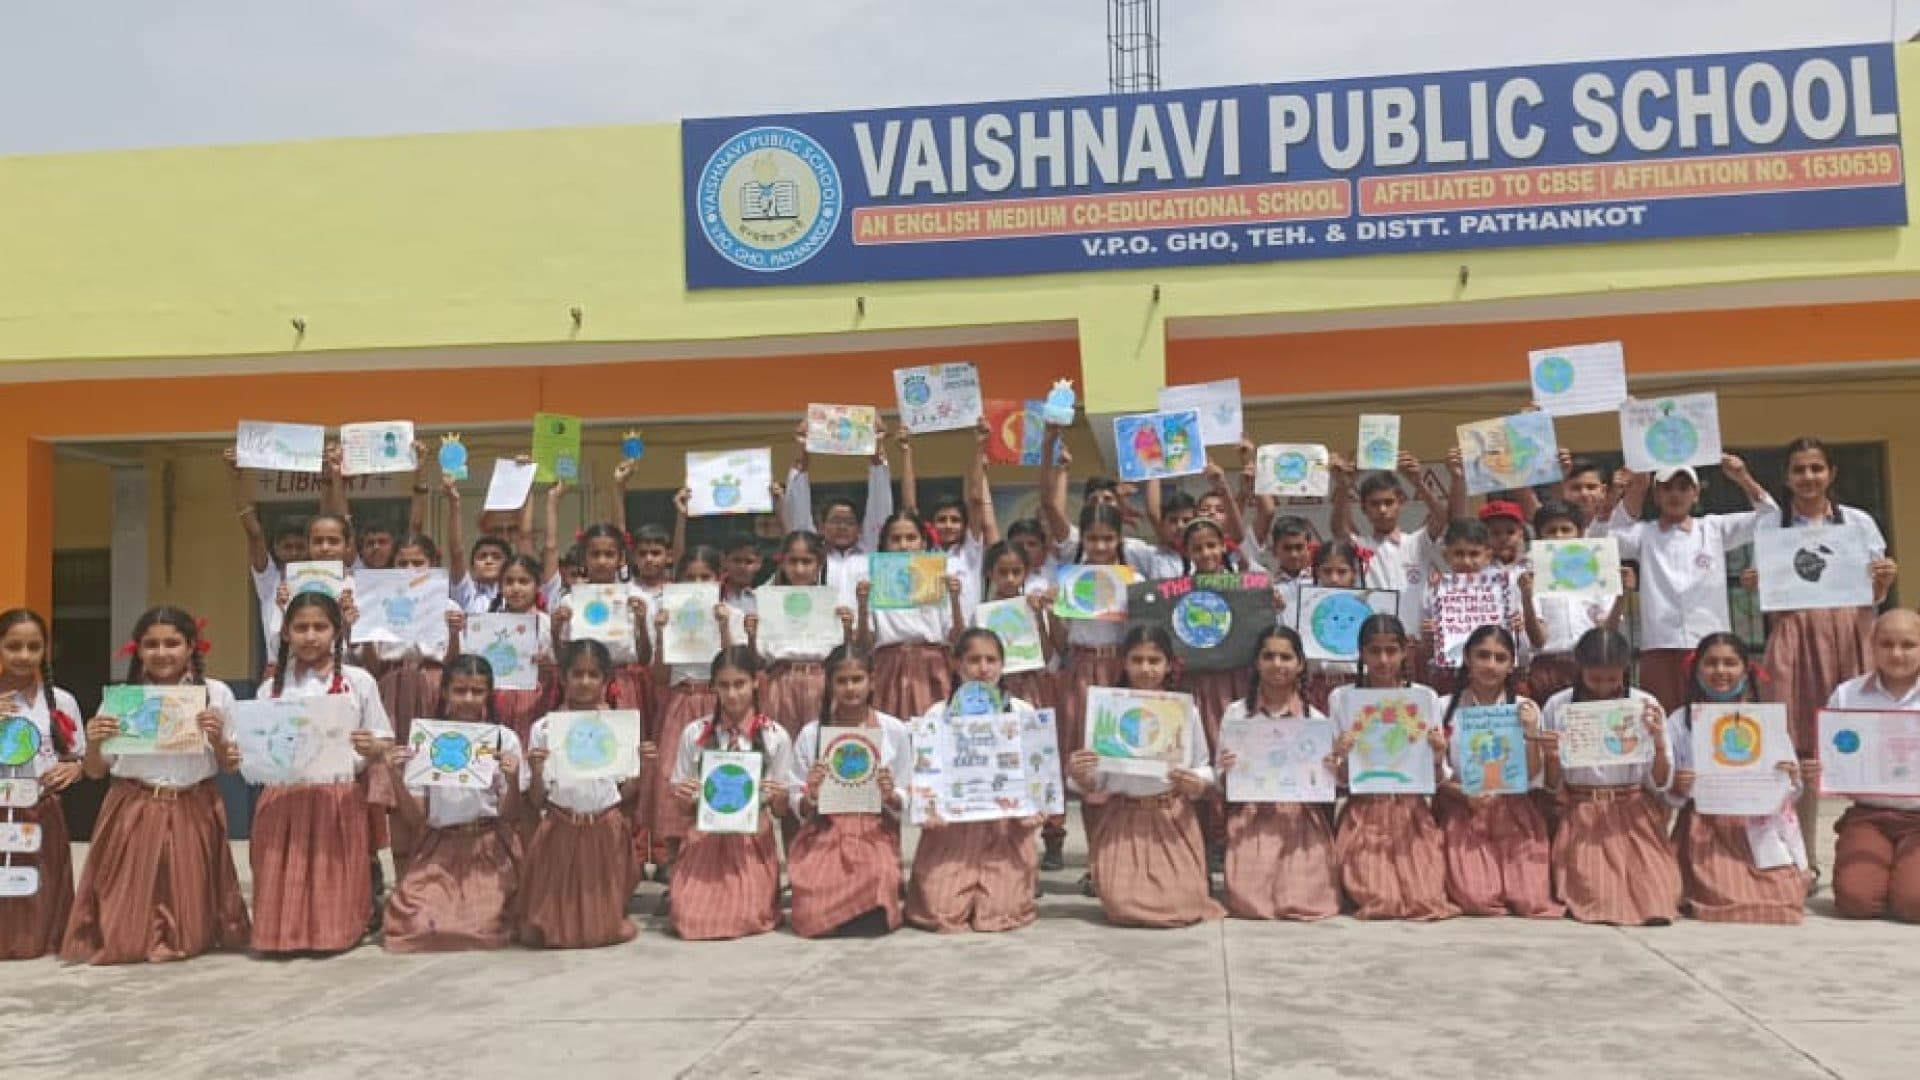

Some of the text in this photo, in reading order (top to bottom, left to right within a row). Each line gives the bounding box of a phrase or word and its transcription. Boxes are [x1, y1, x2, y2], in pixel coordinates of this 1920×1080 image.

[853, 55, 1899, 197] VAISHNAVI PUBLIC SCHOOL
[749, 133, 802, 153] PUBLIC
[803, 147, 836, 206] SCHOOL
[1373, 151, 1893, 205] AFFILIATED TO CBSE AFFILIATION NO. 1630639
[860, 185, 1345, 237] AN ENGLISH MEDIUM CO-EDUCATIONAL SCHOOL
[1081, 205, 1648, 257] V.P.O. GHO, TEH. & DISTT. PATHANKOT
